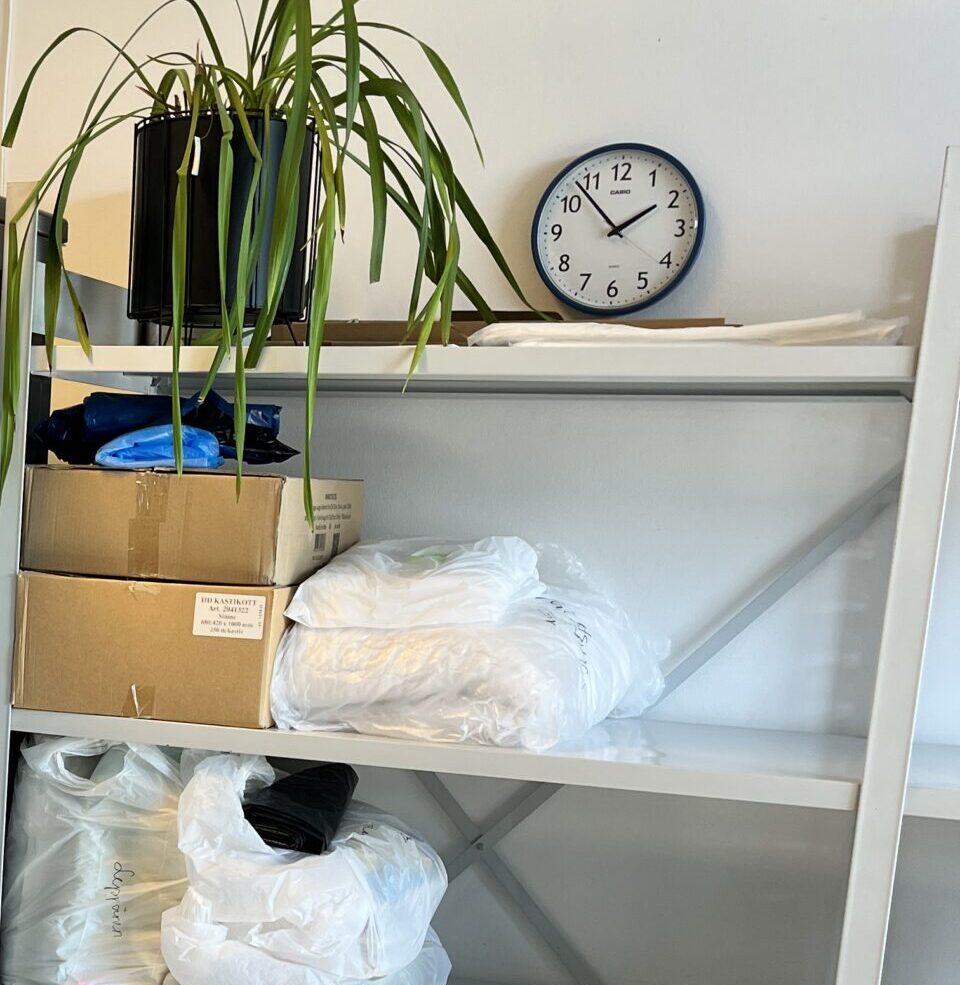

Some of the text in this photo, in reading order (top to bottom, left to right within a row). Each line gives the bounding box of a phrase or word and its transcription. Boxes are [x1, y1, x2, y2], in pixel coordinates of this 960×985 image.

[611, 162, 632, 181] 12
[648, 169, 657, 187] 1
[583, 172, 600, 191] 11
[560, 194, 581, 213] 10
[667, 190, 680, 209] 2
[551, 224, 562, 242] 9
[674, 219, 685, 237] 3
[558, 254, 570, 272] 8
[659, 251, 672, 269] 4
[579, 273, 592, 291] 7
[606, 280, 618, 298] 6
[637, 271, 648, 289] 5
